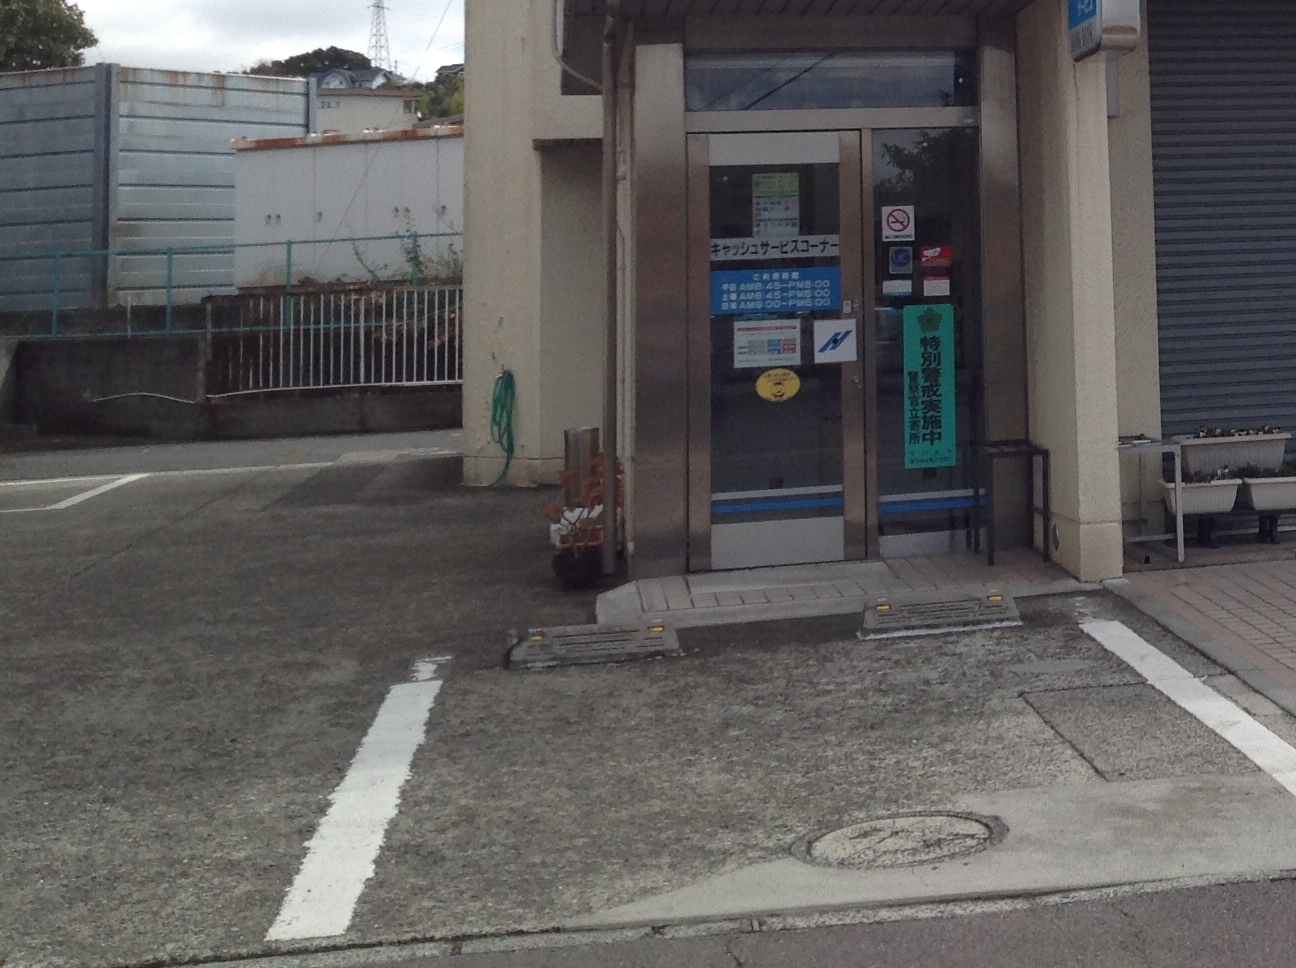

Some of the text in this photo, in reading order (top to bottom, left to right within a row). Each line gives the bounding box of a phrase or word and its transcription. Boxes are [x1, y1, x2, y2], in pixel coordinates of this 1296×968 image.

[711, 237, 839, 257] キャッシュサービスコーナー
[920, 335, 942, 446] 特別警戒実施中
